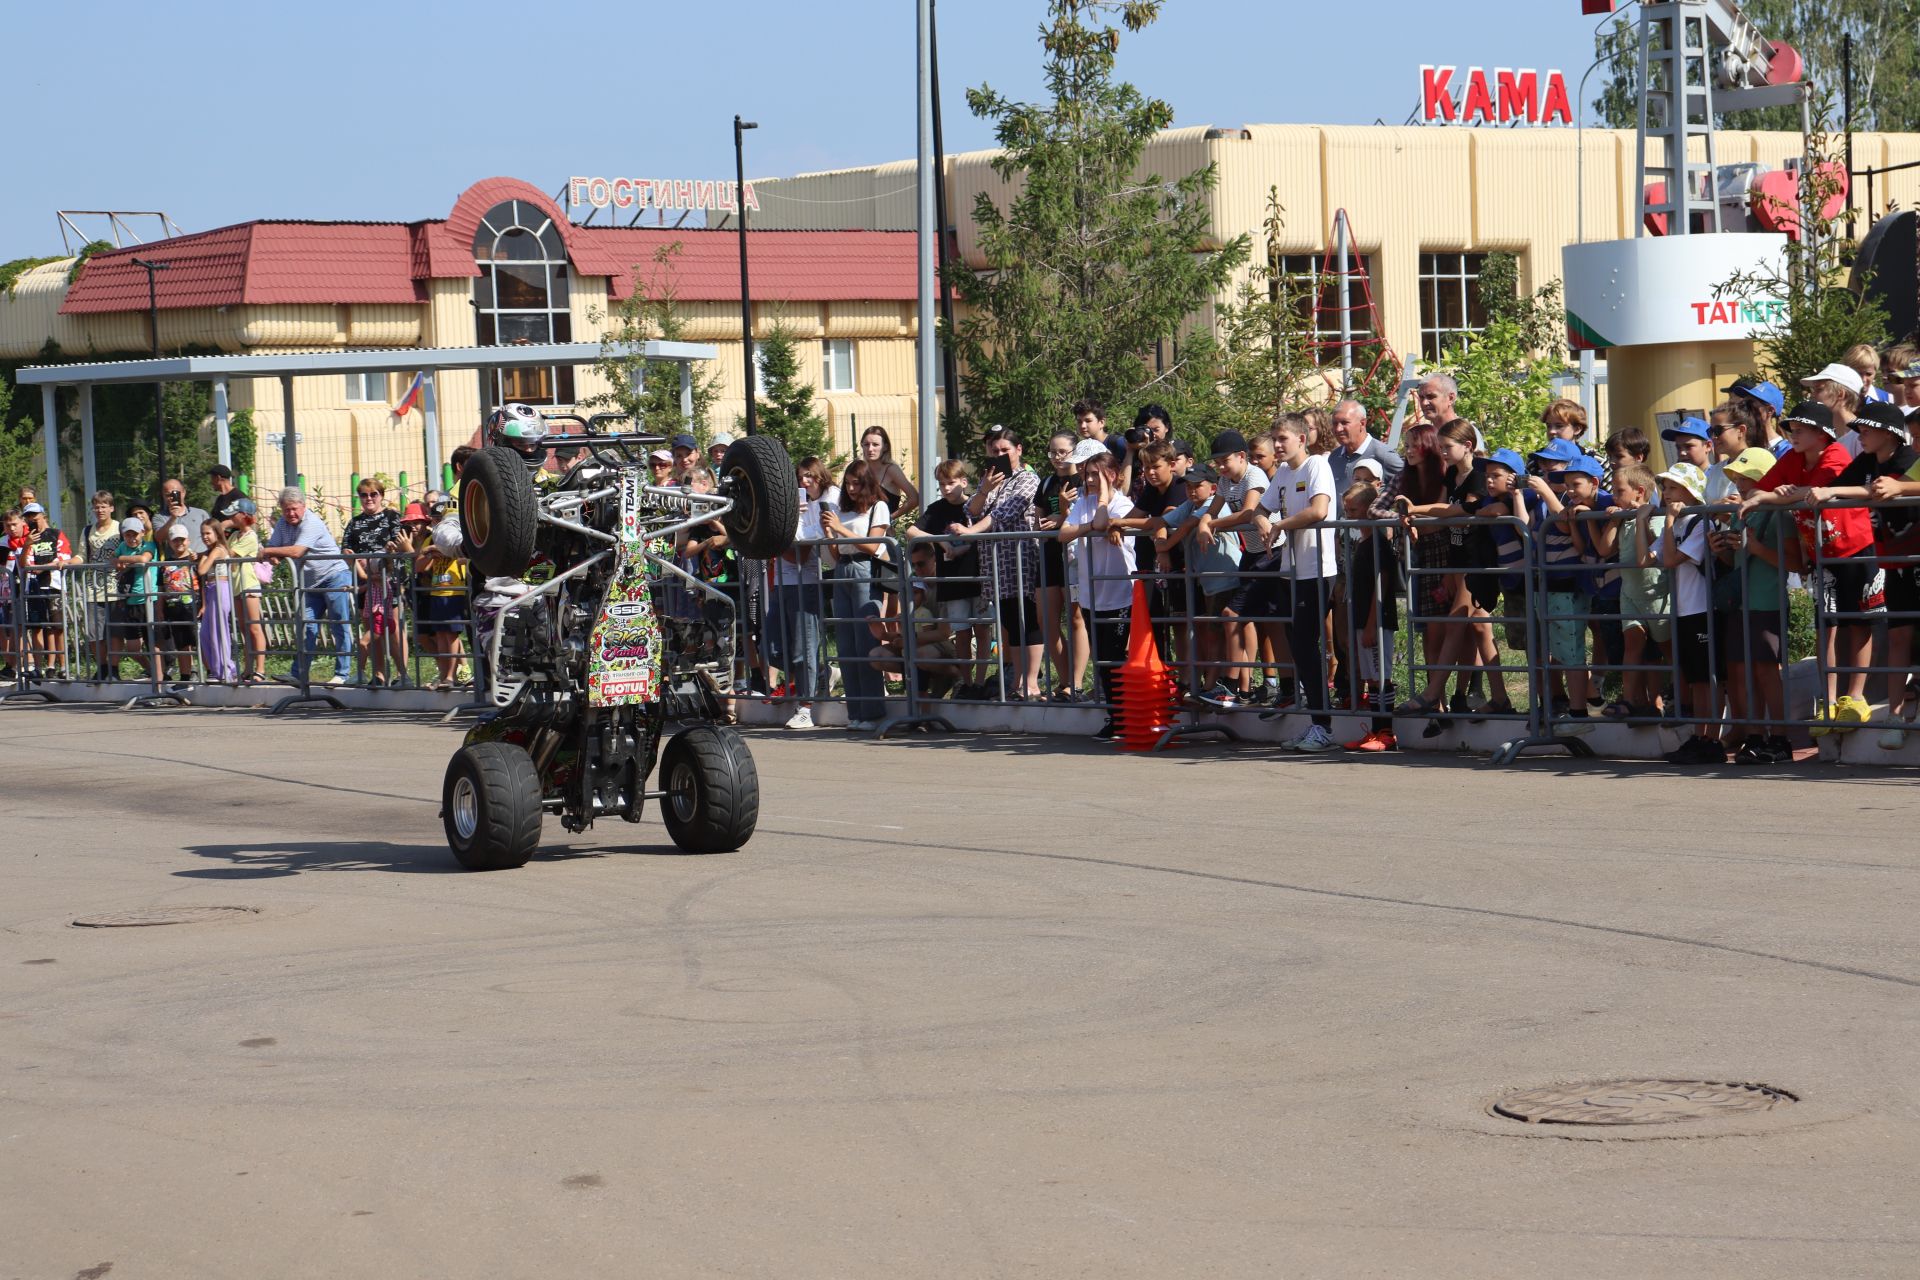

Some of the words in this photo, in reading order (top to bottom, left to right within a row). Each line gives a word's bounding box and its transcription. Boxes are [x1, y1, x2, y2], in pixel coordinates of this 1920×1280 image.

[1419, 64, 1573, 126] КАМА
[569, 176, 760, 215] ГОСТИНИЦА
[1691, 300, 1786, 325] TATNEFT
[625, 480, 635, 514] TEAM
[604, 681, 645, 695] MOTUL
